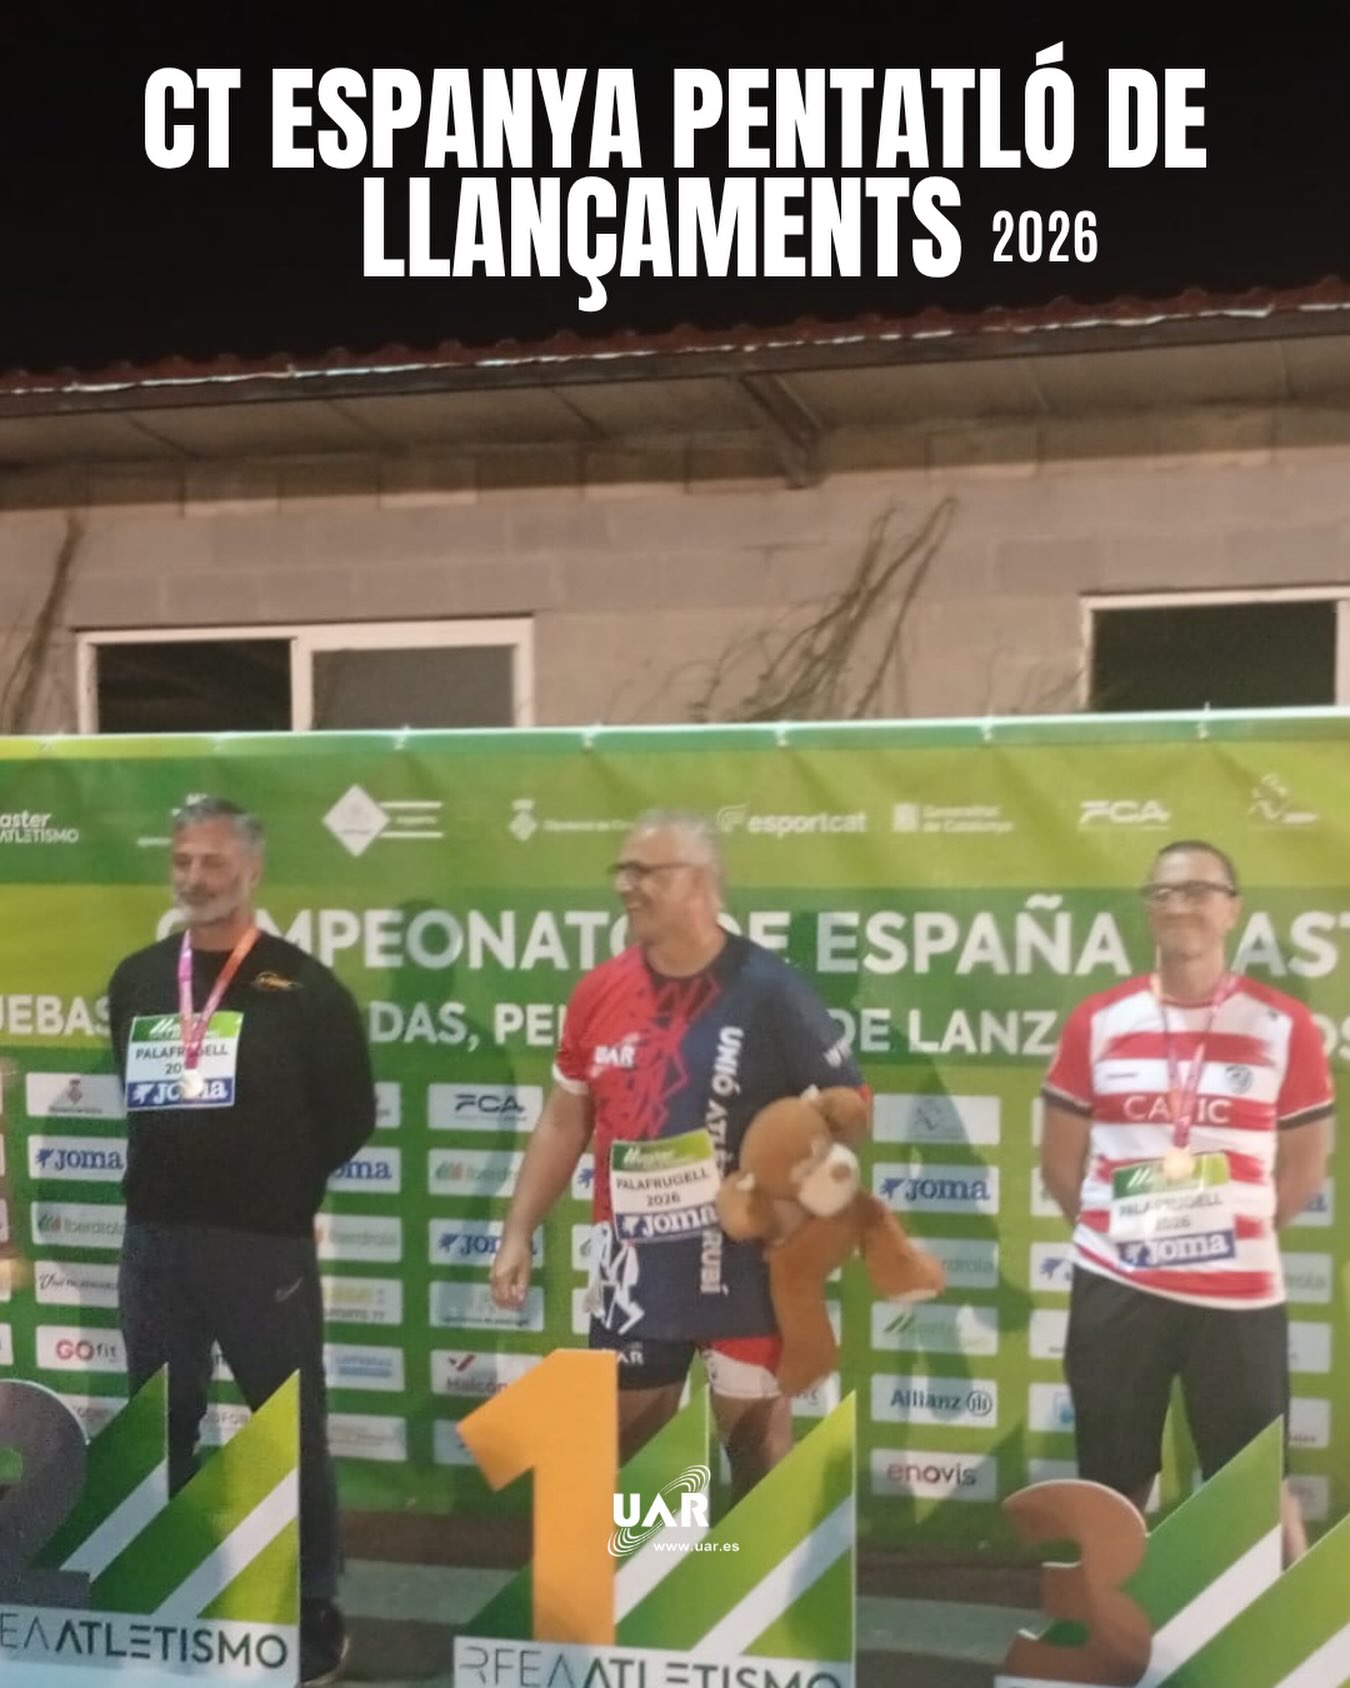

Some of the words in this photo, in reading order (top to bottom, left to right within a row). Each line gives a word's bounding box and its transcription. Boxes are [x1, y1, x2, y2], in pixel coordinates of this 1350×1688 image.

[0, 810, 51, 828] aster
[747, 811, 868, 839] esportcat
[816, 892, 1132, 975] ESPAÑA
[454, 1094, 525, 1113] FCA
[616, 1167, 709, 1190] PALAFRUGELL
[646, 1191, 681, 1206] 2026
[890, 1389, 962, 1411] Allianz
[886, 1461, 979, 1487] enovis
